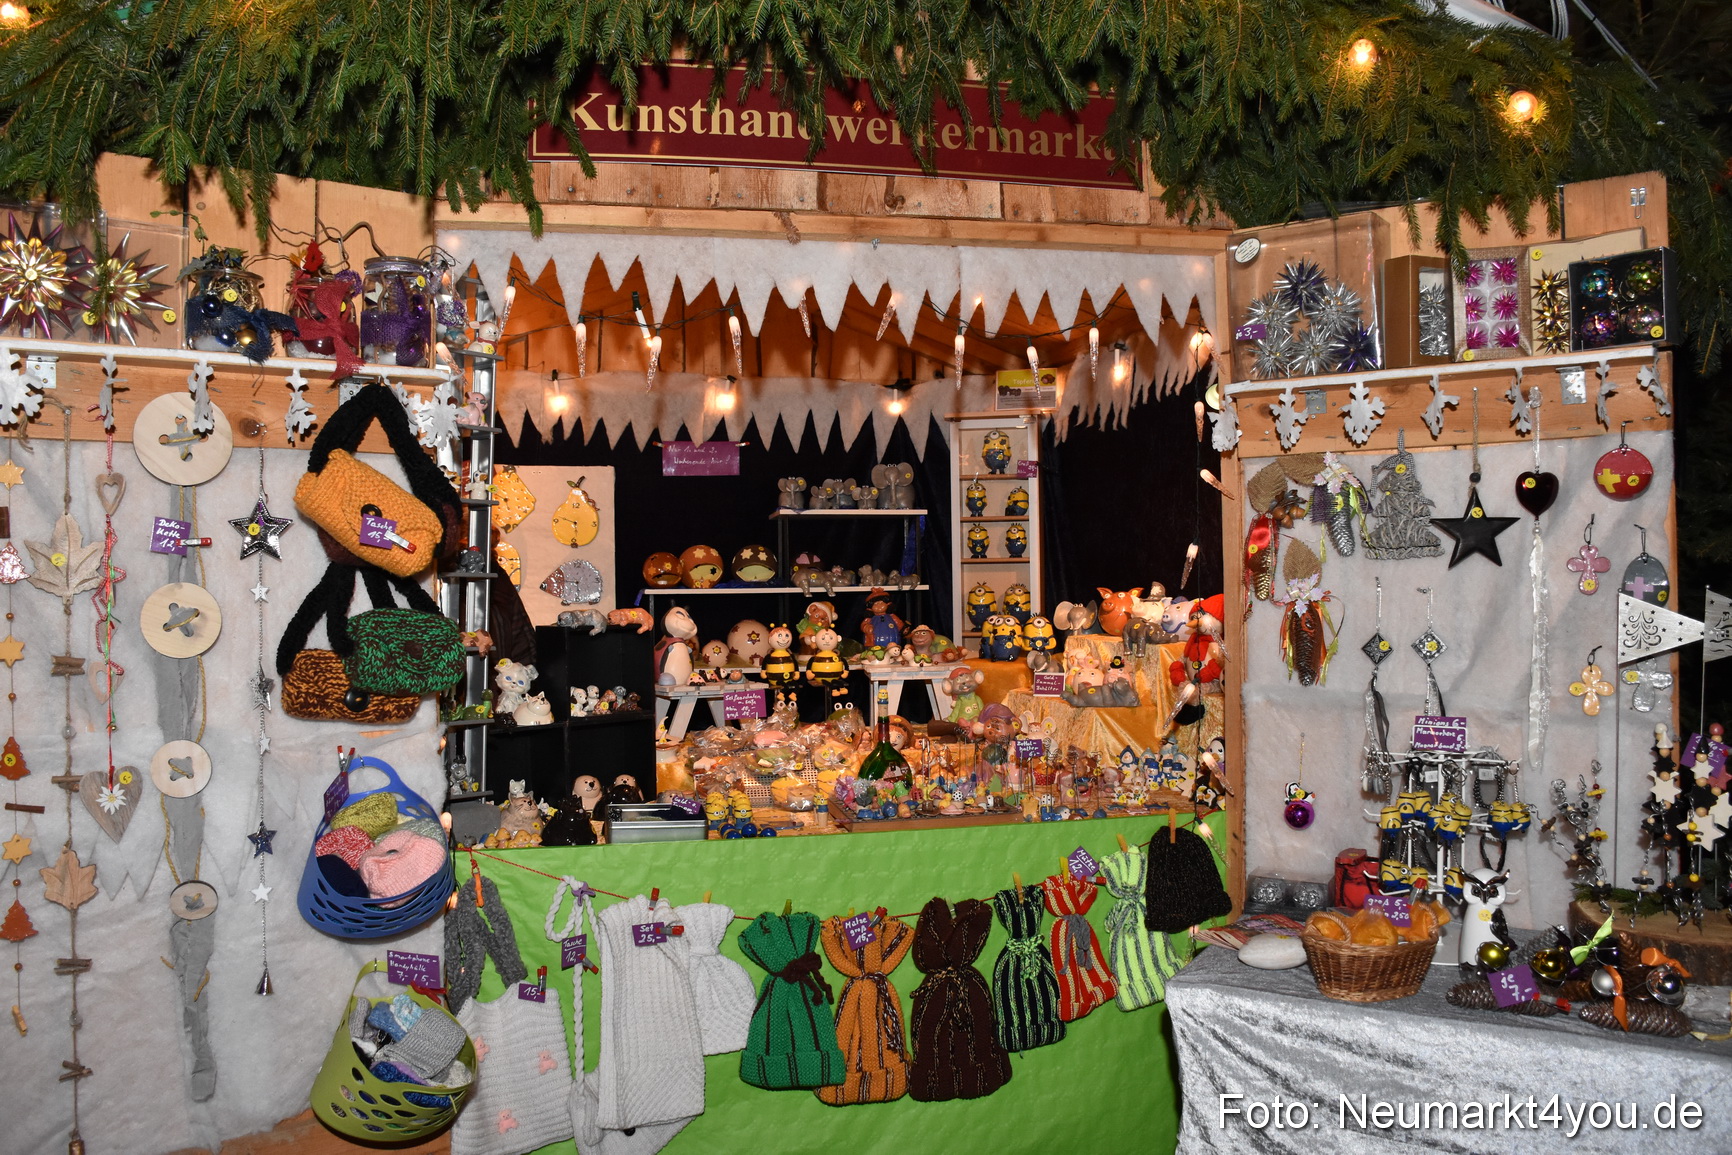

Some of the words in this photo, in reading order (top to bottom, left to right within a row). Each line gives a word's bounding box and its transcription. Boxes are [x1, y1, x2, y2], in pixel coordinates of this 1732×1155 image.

[1235, 329, 1242, 340] je
[1243, 327, 1258, 340] 3,-
[366, 517, 393, 532] Tasche
[156, 527, 181, 539] Kette
[1417, 717, 1450, 727] Minions
[1367, 898, 1389, 907] groß
[1394, 899, 1408, 910] 5,-
[1391, 911, 1410, 921] 2,50
[640, 924, 654, 933] Set
[849, 925, 867, 937] groß
[638, 933, 662, 944] 25,-
[1501, 972, 1515, 989] je
[523, 986, 541, 1000] 15,-
[1508, 984, 1532, 1002] 7,-
